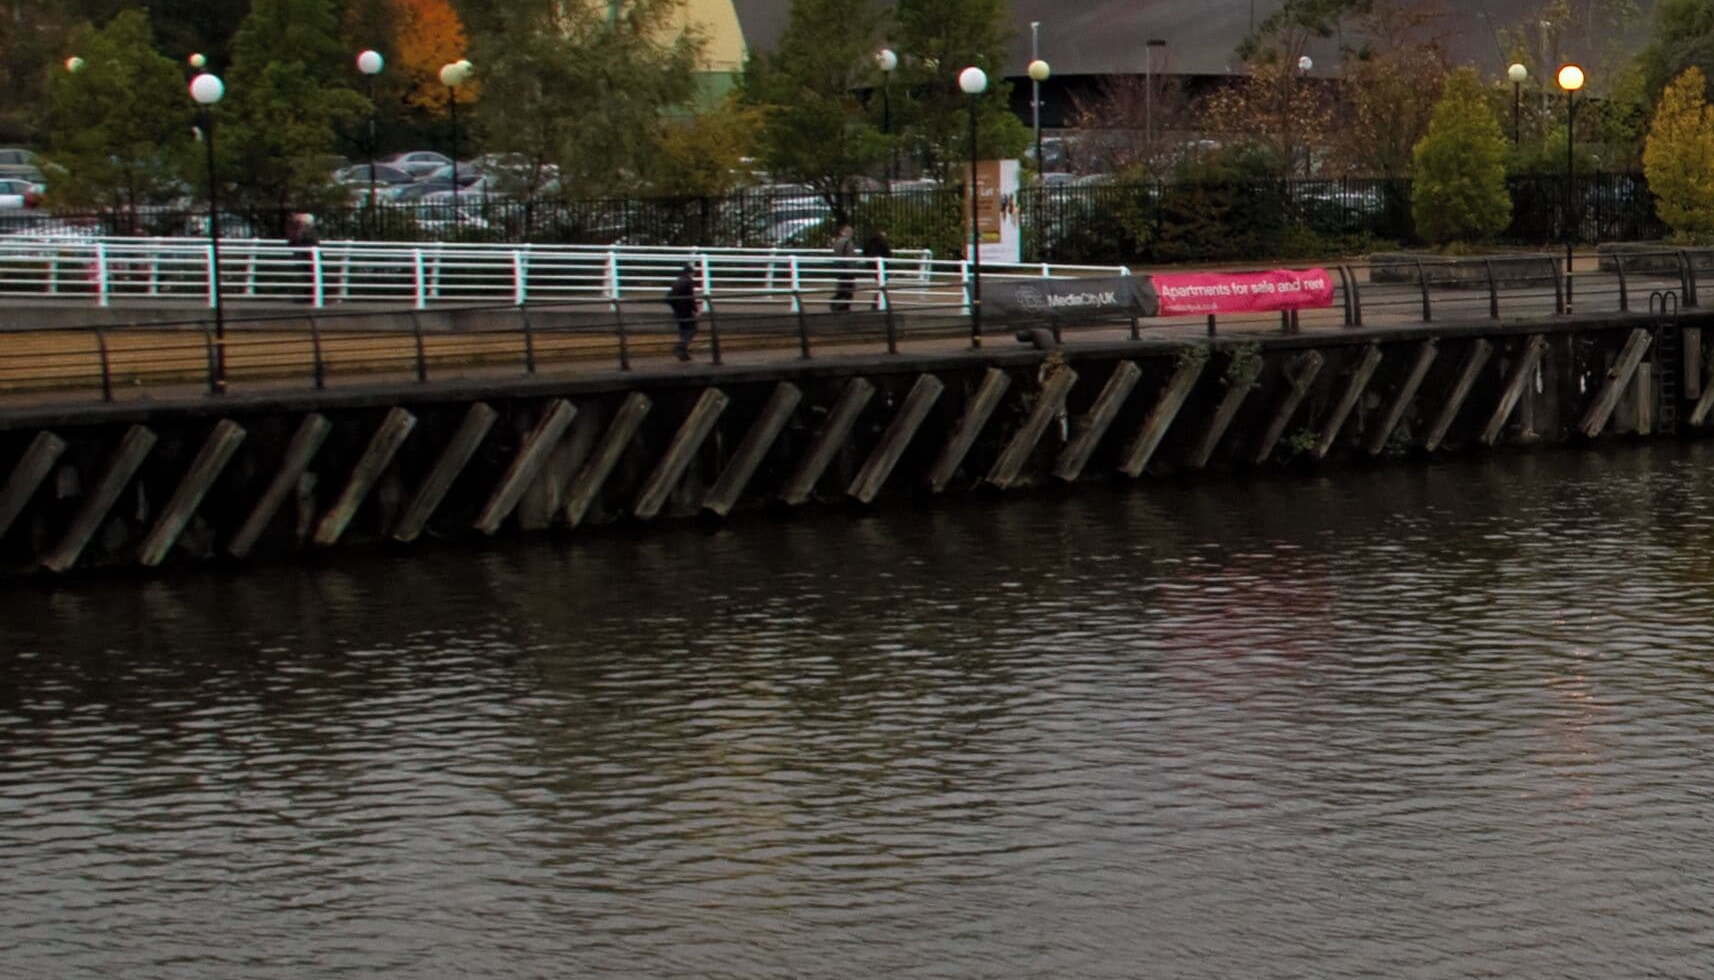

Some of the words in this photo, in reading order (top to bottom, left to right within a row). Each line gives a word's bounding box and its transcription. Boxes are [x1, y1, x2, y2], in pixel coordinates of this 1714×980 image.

[1162, 282, 1231, 301] Apartments
[1231, 281, 1249, 295] for
[1251, 280, 1275, 294] sale
[1277, 277, 1300, 292] and
[1303, 278, 1325, 290] rent
[1046, 291, 1117, 308] MediaCityUK
